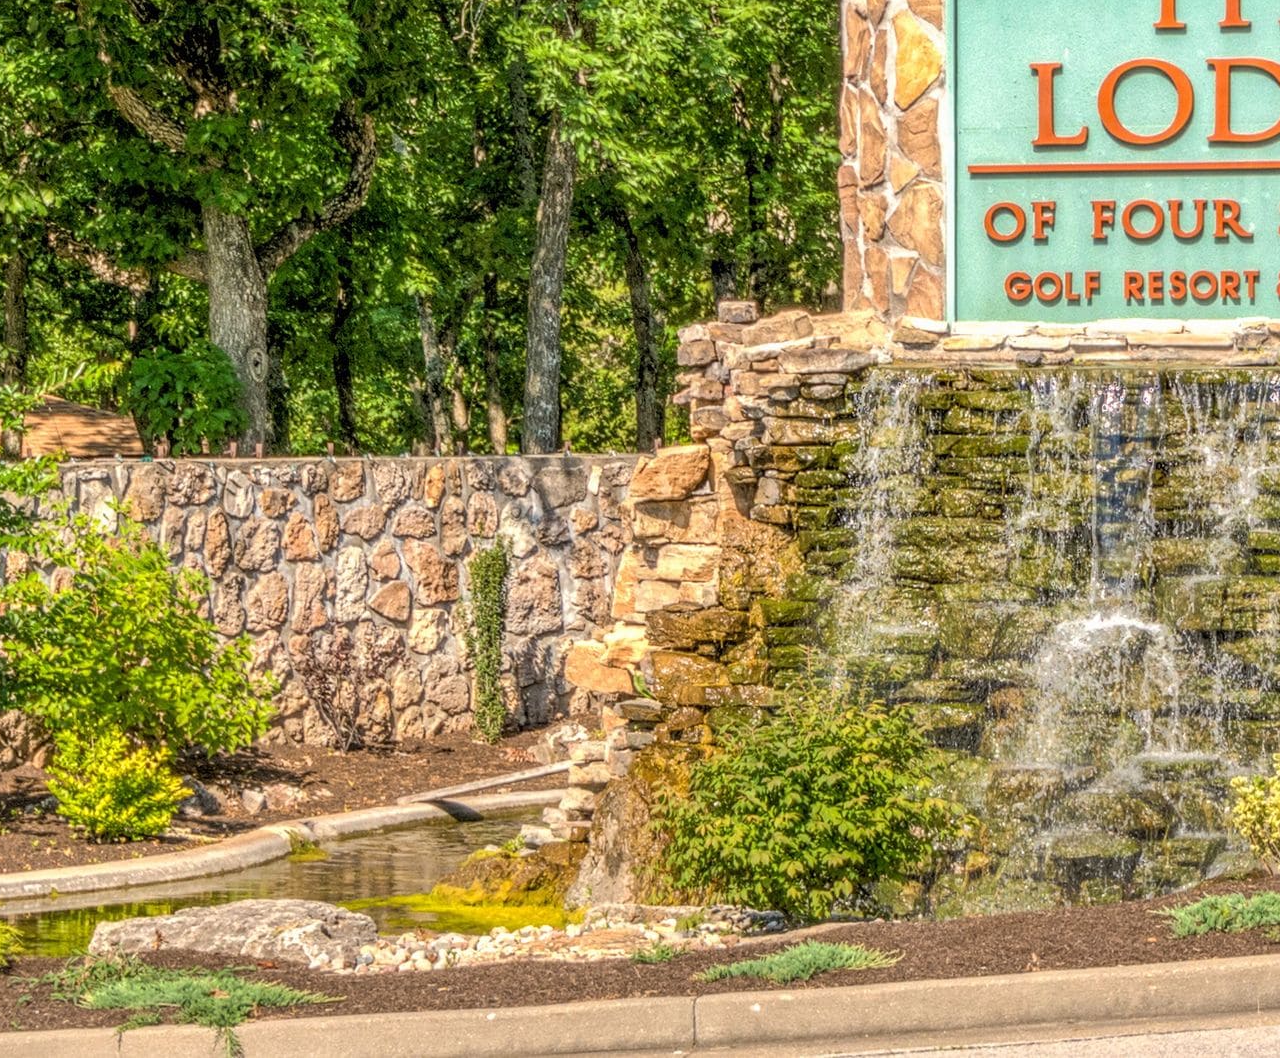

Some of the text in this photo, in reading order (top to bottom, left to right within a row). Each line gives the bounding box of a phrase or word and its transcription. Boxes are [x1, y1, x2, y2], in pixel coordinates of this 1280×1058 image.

[984, 201, 1057, 243] OF
[1092, 199, 1253, 241] FOUR
[1004, 271, 1101, 303] GOLF
[1124, 270, 1261, 302] RESORT
